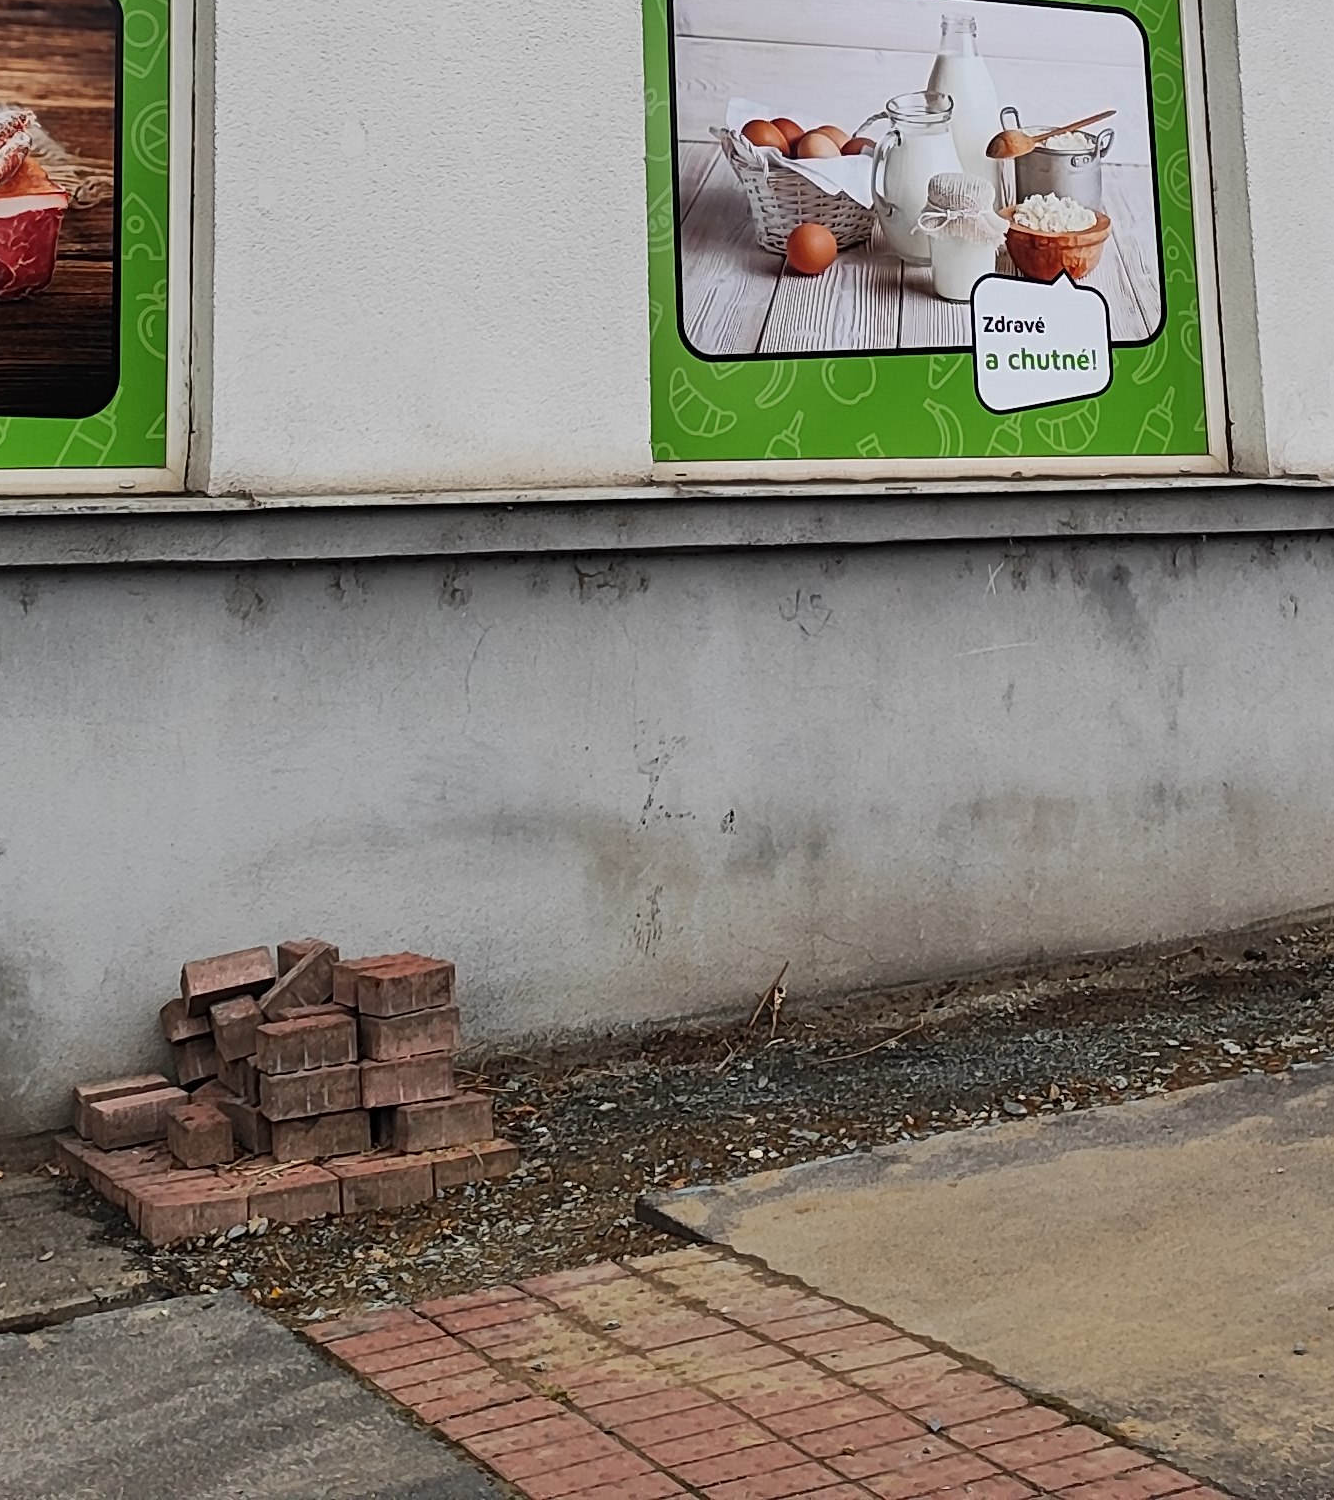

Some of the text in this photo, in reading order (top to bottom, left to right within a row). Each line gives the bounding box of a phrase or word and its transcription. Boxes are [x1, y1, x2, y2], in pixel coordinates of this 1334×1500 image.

[982, 315, 1046, 334] Zdravé
[985, 347, 1098, 371] a chutné!
